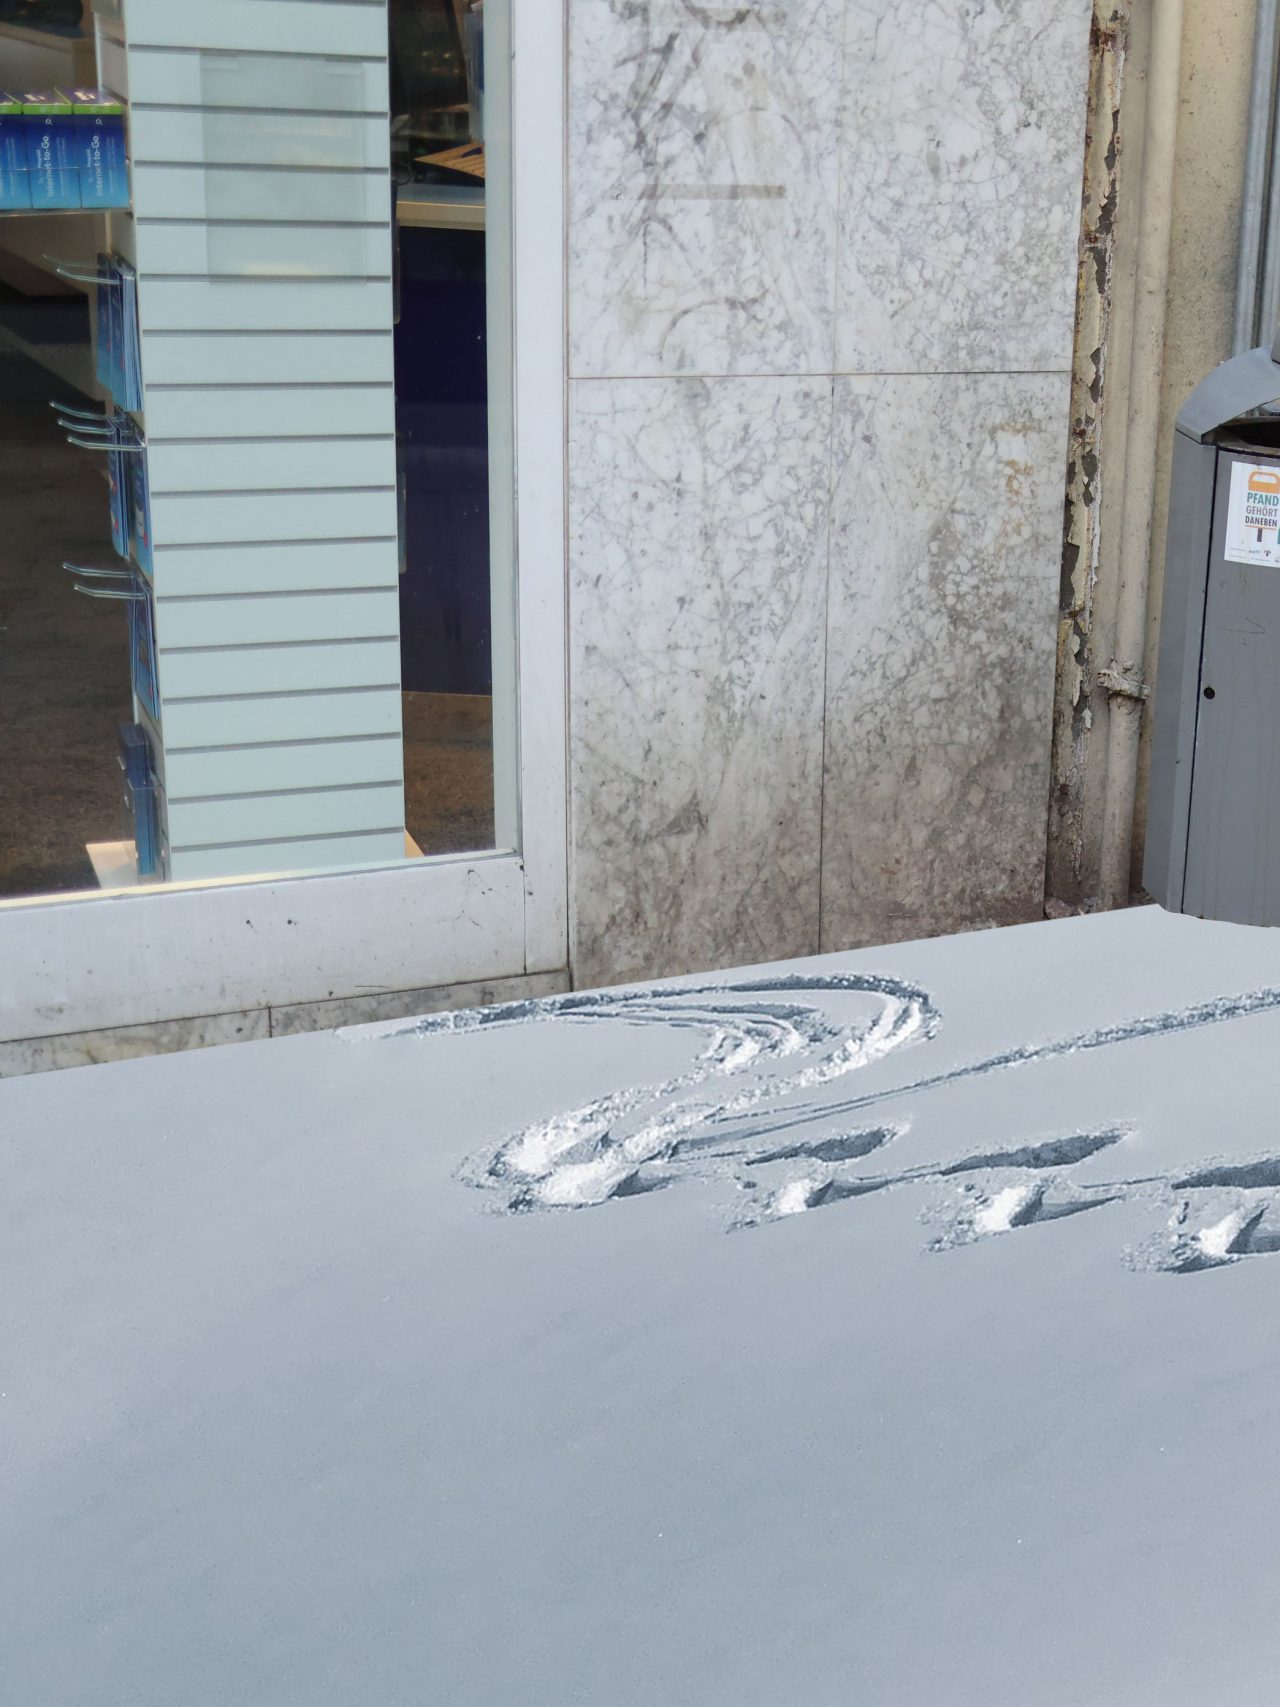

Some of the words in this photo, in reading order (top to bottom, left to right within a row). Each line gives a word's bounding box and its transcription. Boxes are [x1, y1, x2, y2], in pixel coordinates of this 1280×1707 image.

[1247, 492, 1279, 507] PFAND
[1246, 505, 1278, 518] GEHÖRT
[1245, 516, 1278, 527] DANEBEN
